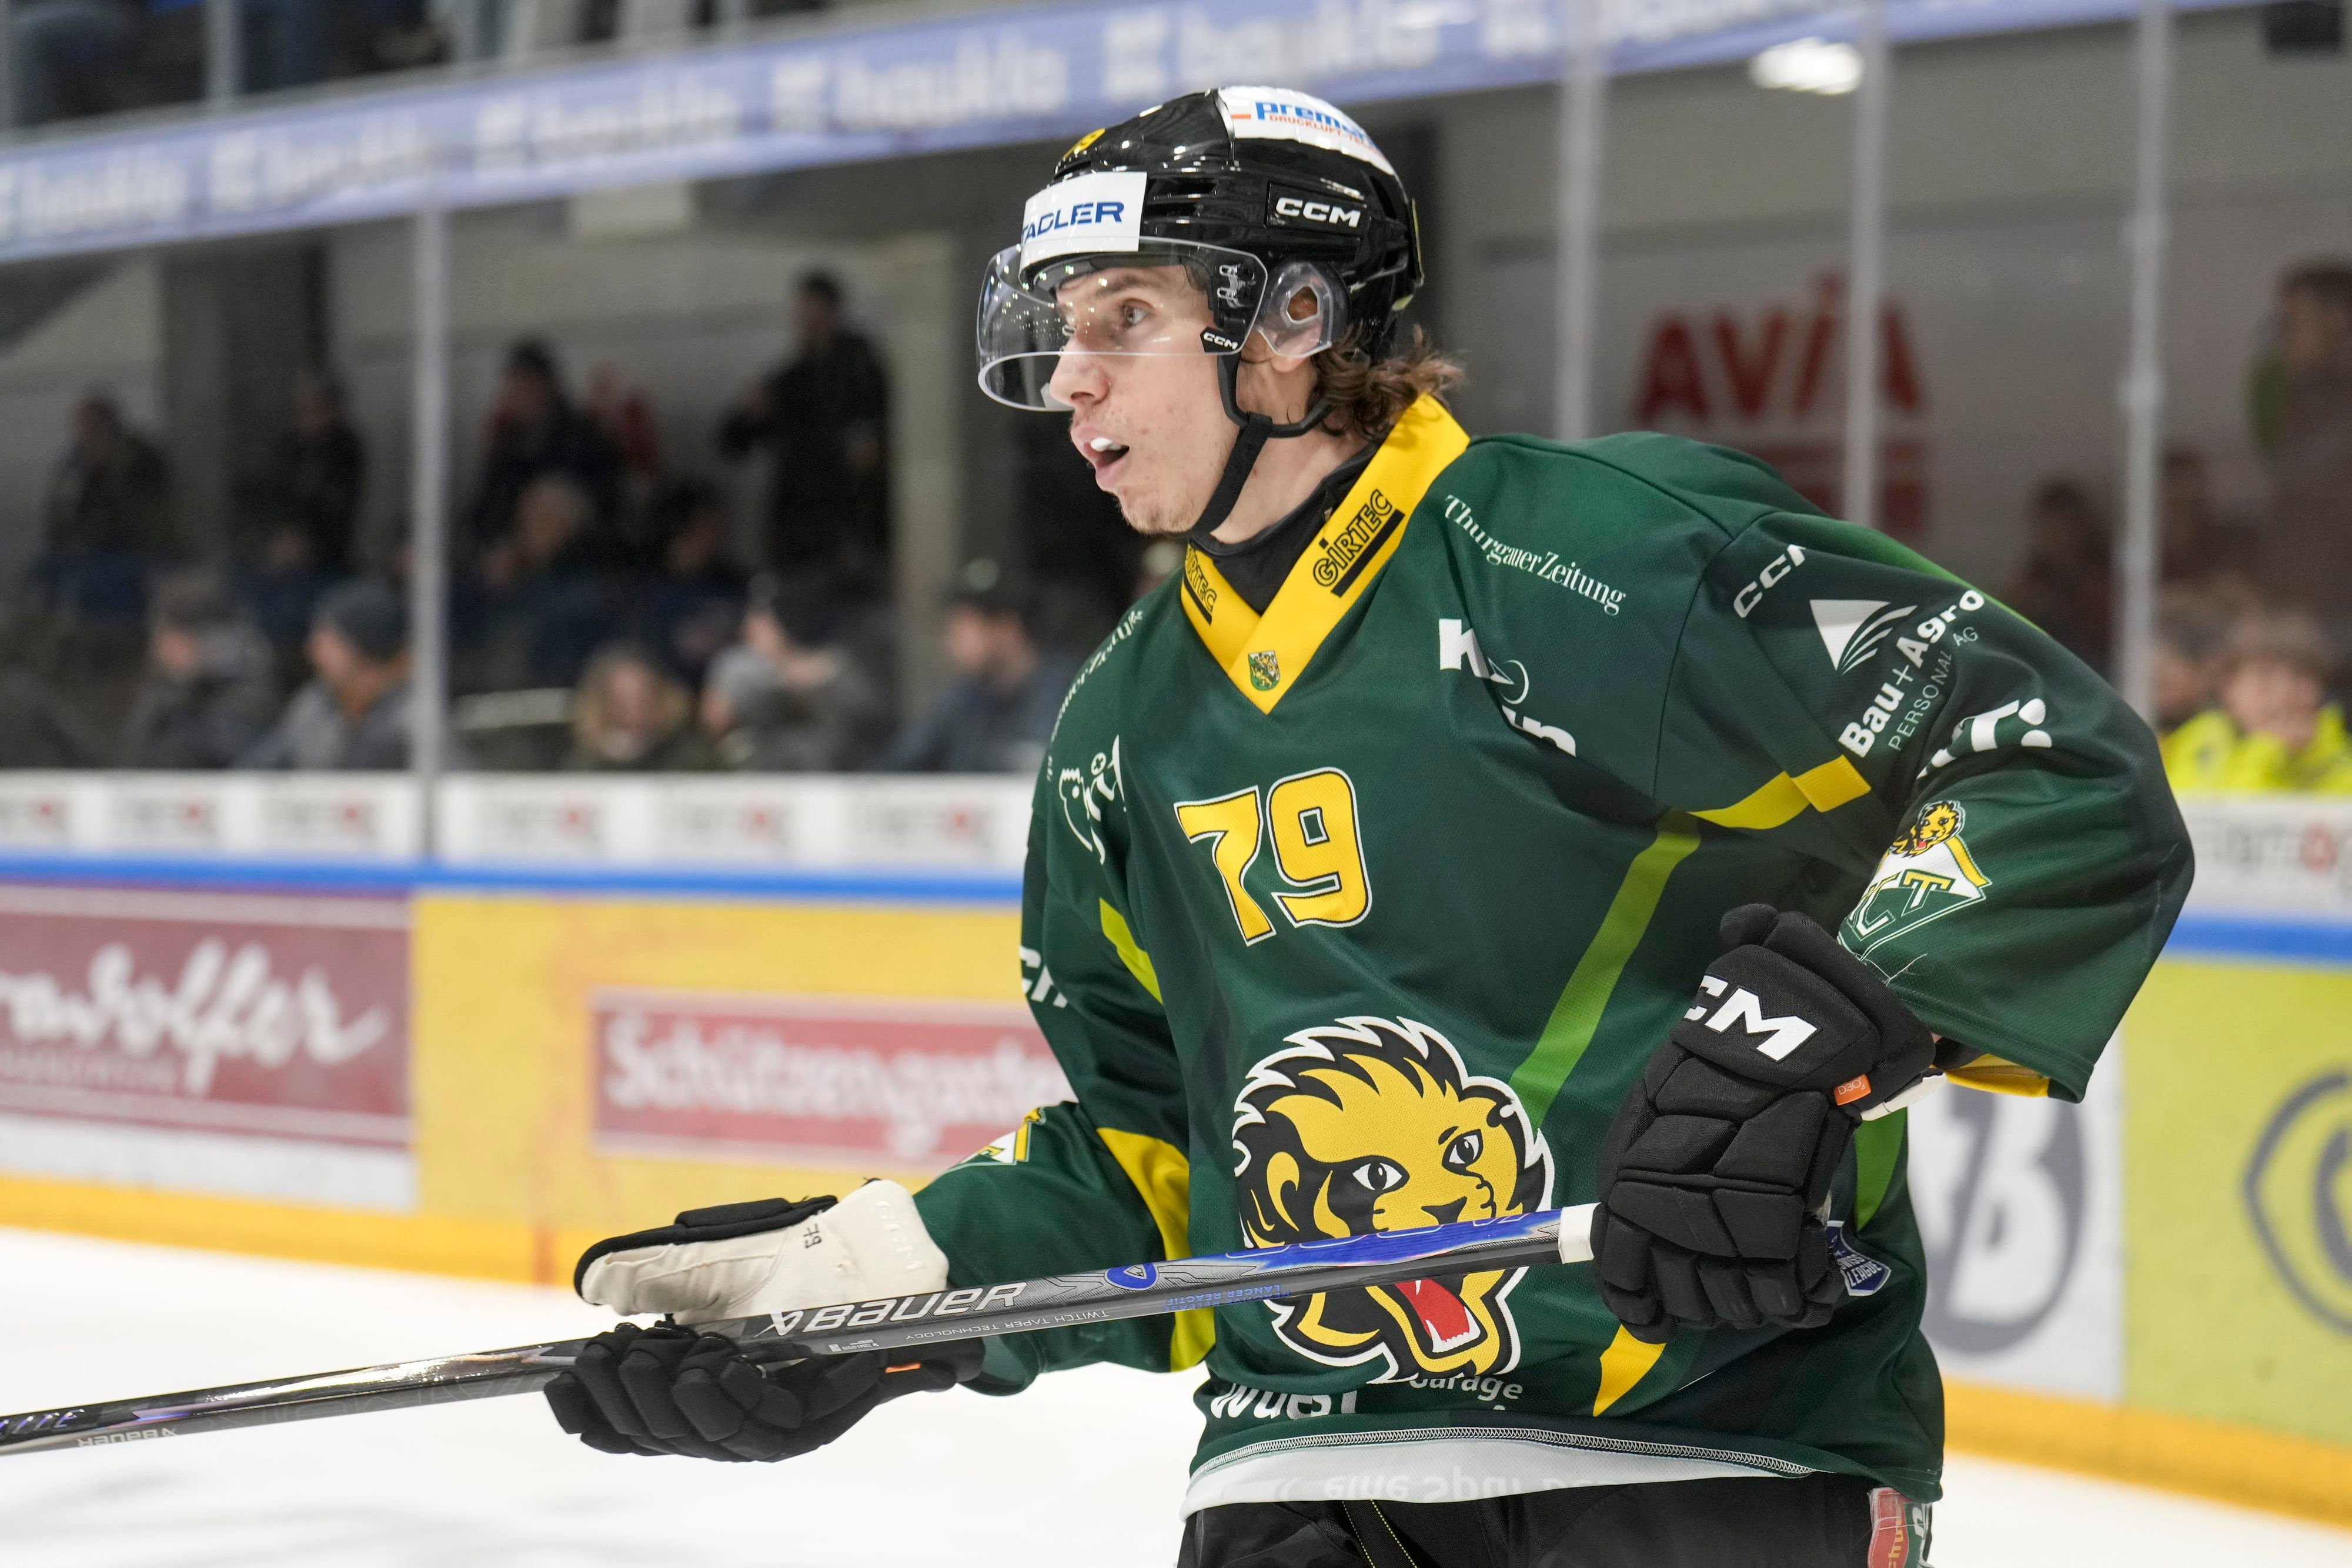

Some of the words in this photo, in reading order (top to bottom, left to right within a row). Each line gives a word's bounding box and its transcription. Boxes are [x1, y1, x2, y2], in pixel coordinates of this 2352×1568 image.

[1275, 197, 1361, 228] CCM
[1203, 332, 1238, 350] CCM
[1312, 489, 1393, 587] GIRTEC
[1888, 650, 1953, 752] PERSONAL
[1953, 626, 1980, 647] AG
[1173, 766, 1373, 947] 79
[1846, 1261, 1882, 1288] LEAGUE
[1165, 1291, 1222, 1306] REACTIF
[1227, 1283, 1282, 1299] LANCER
[1004, 1316, 1050, 1329] TAPER
[1054, 1309, 1110, 1323] TWITCH
[904, 1323, 1000, 1340] TECHNOLOGY
